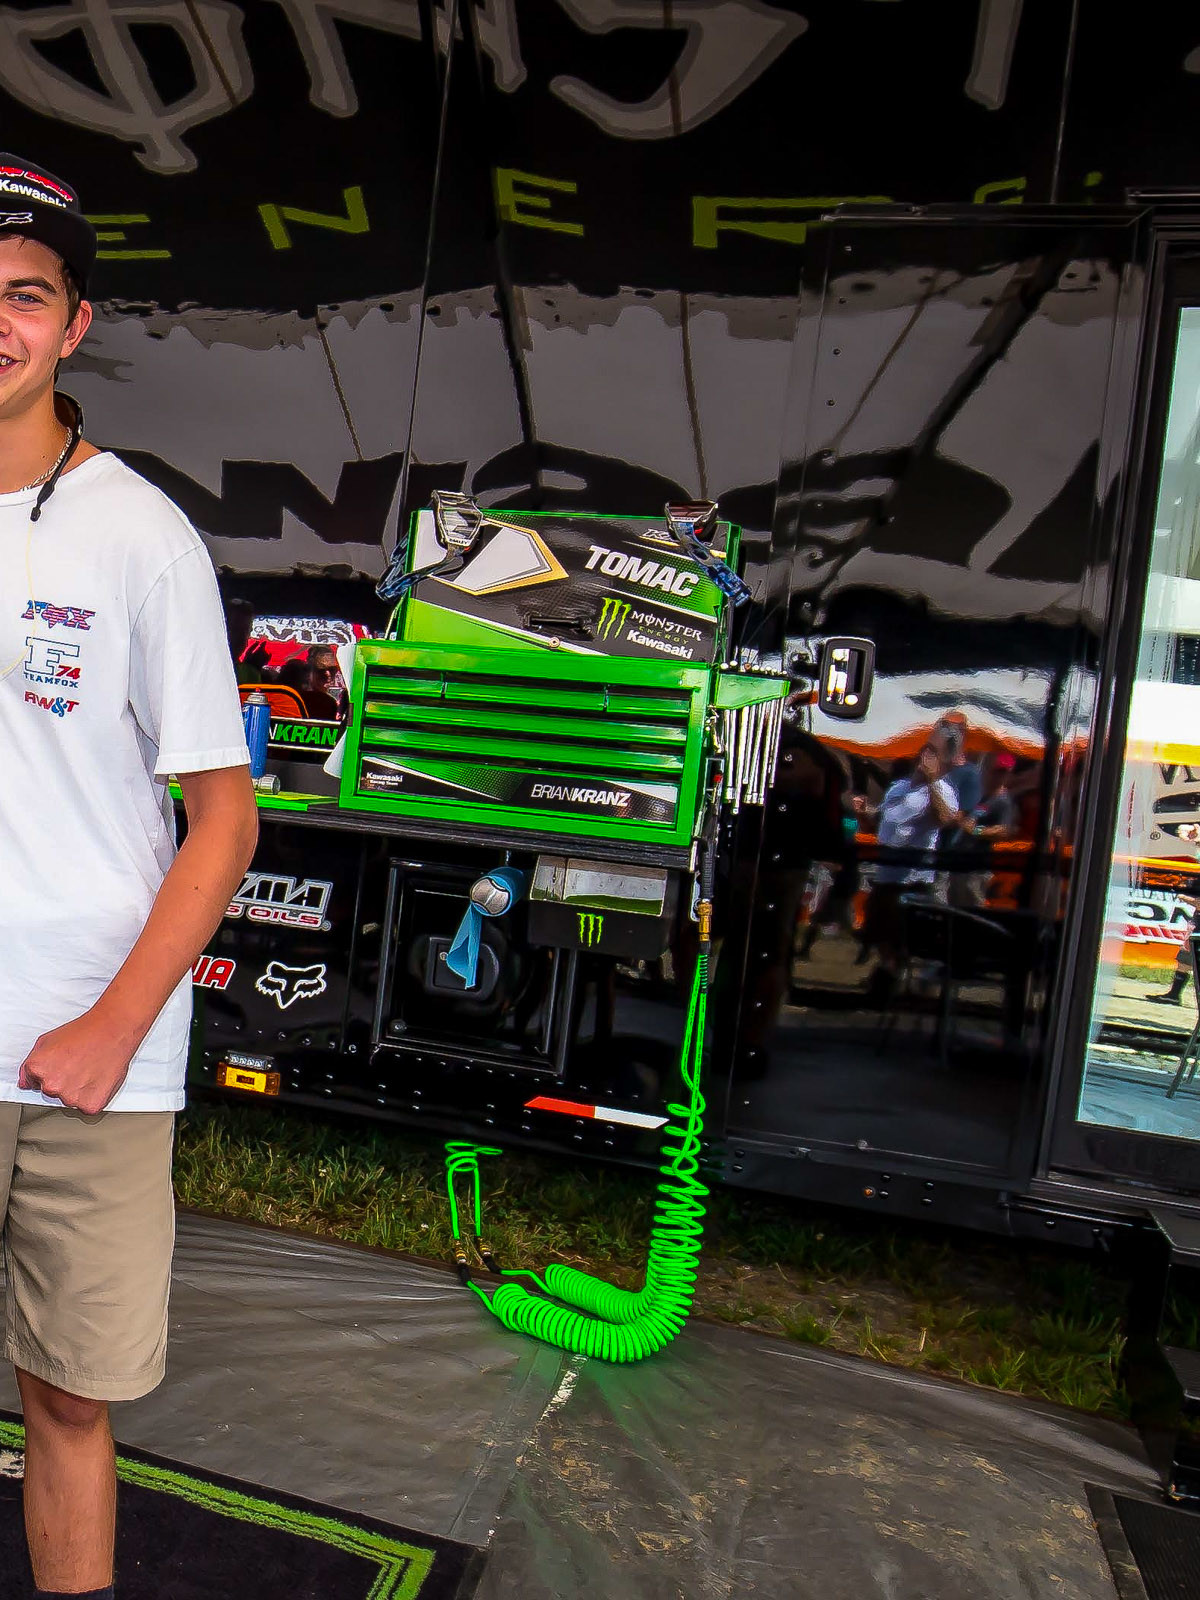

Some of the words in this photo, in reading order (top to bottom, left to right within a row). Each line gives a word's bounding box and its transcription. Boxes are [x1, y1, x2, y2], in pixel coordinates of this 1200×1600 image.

[584, 545, 700, 598] TOMAC
[631, 610, 702, 641] MONSTER
[626, 629, 694, 660] Kawasaki
[56, 665, 81, 680] 74
[366, 772, 404, 783] Kawasaki
[248, 905, 322, 928] OILS
